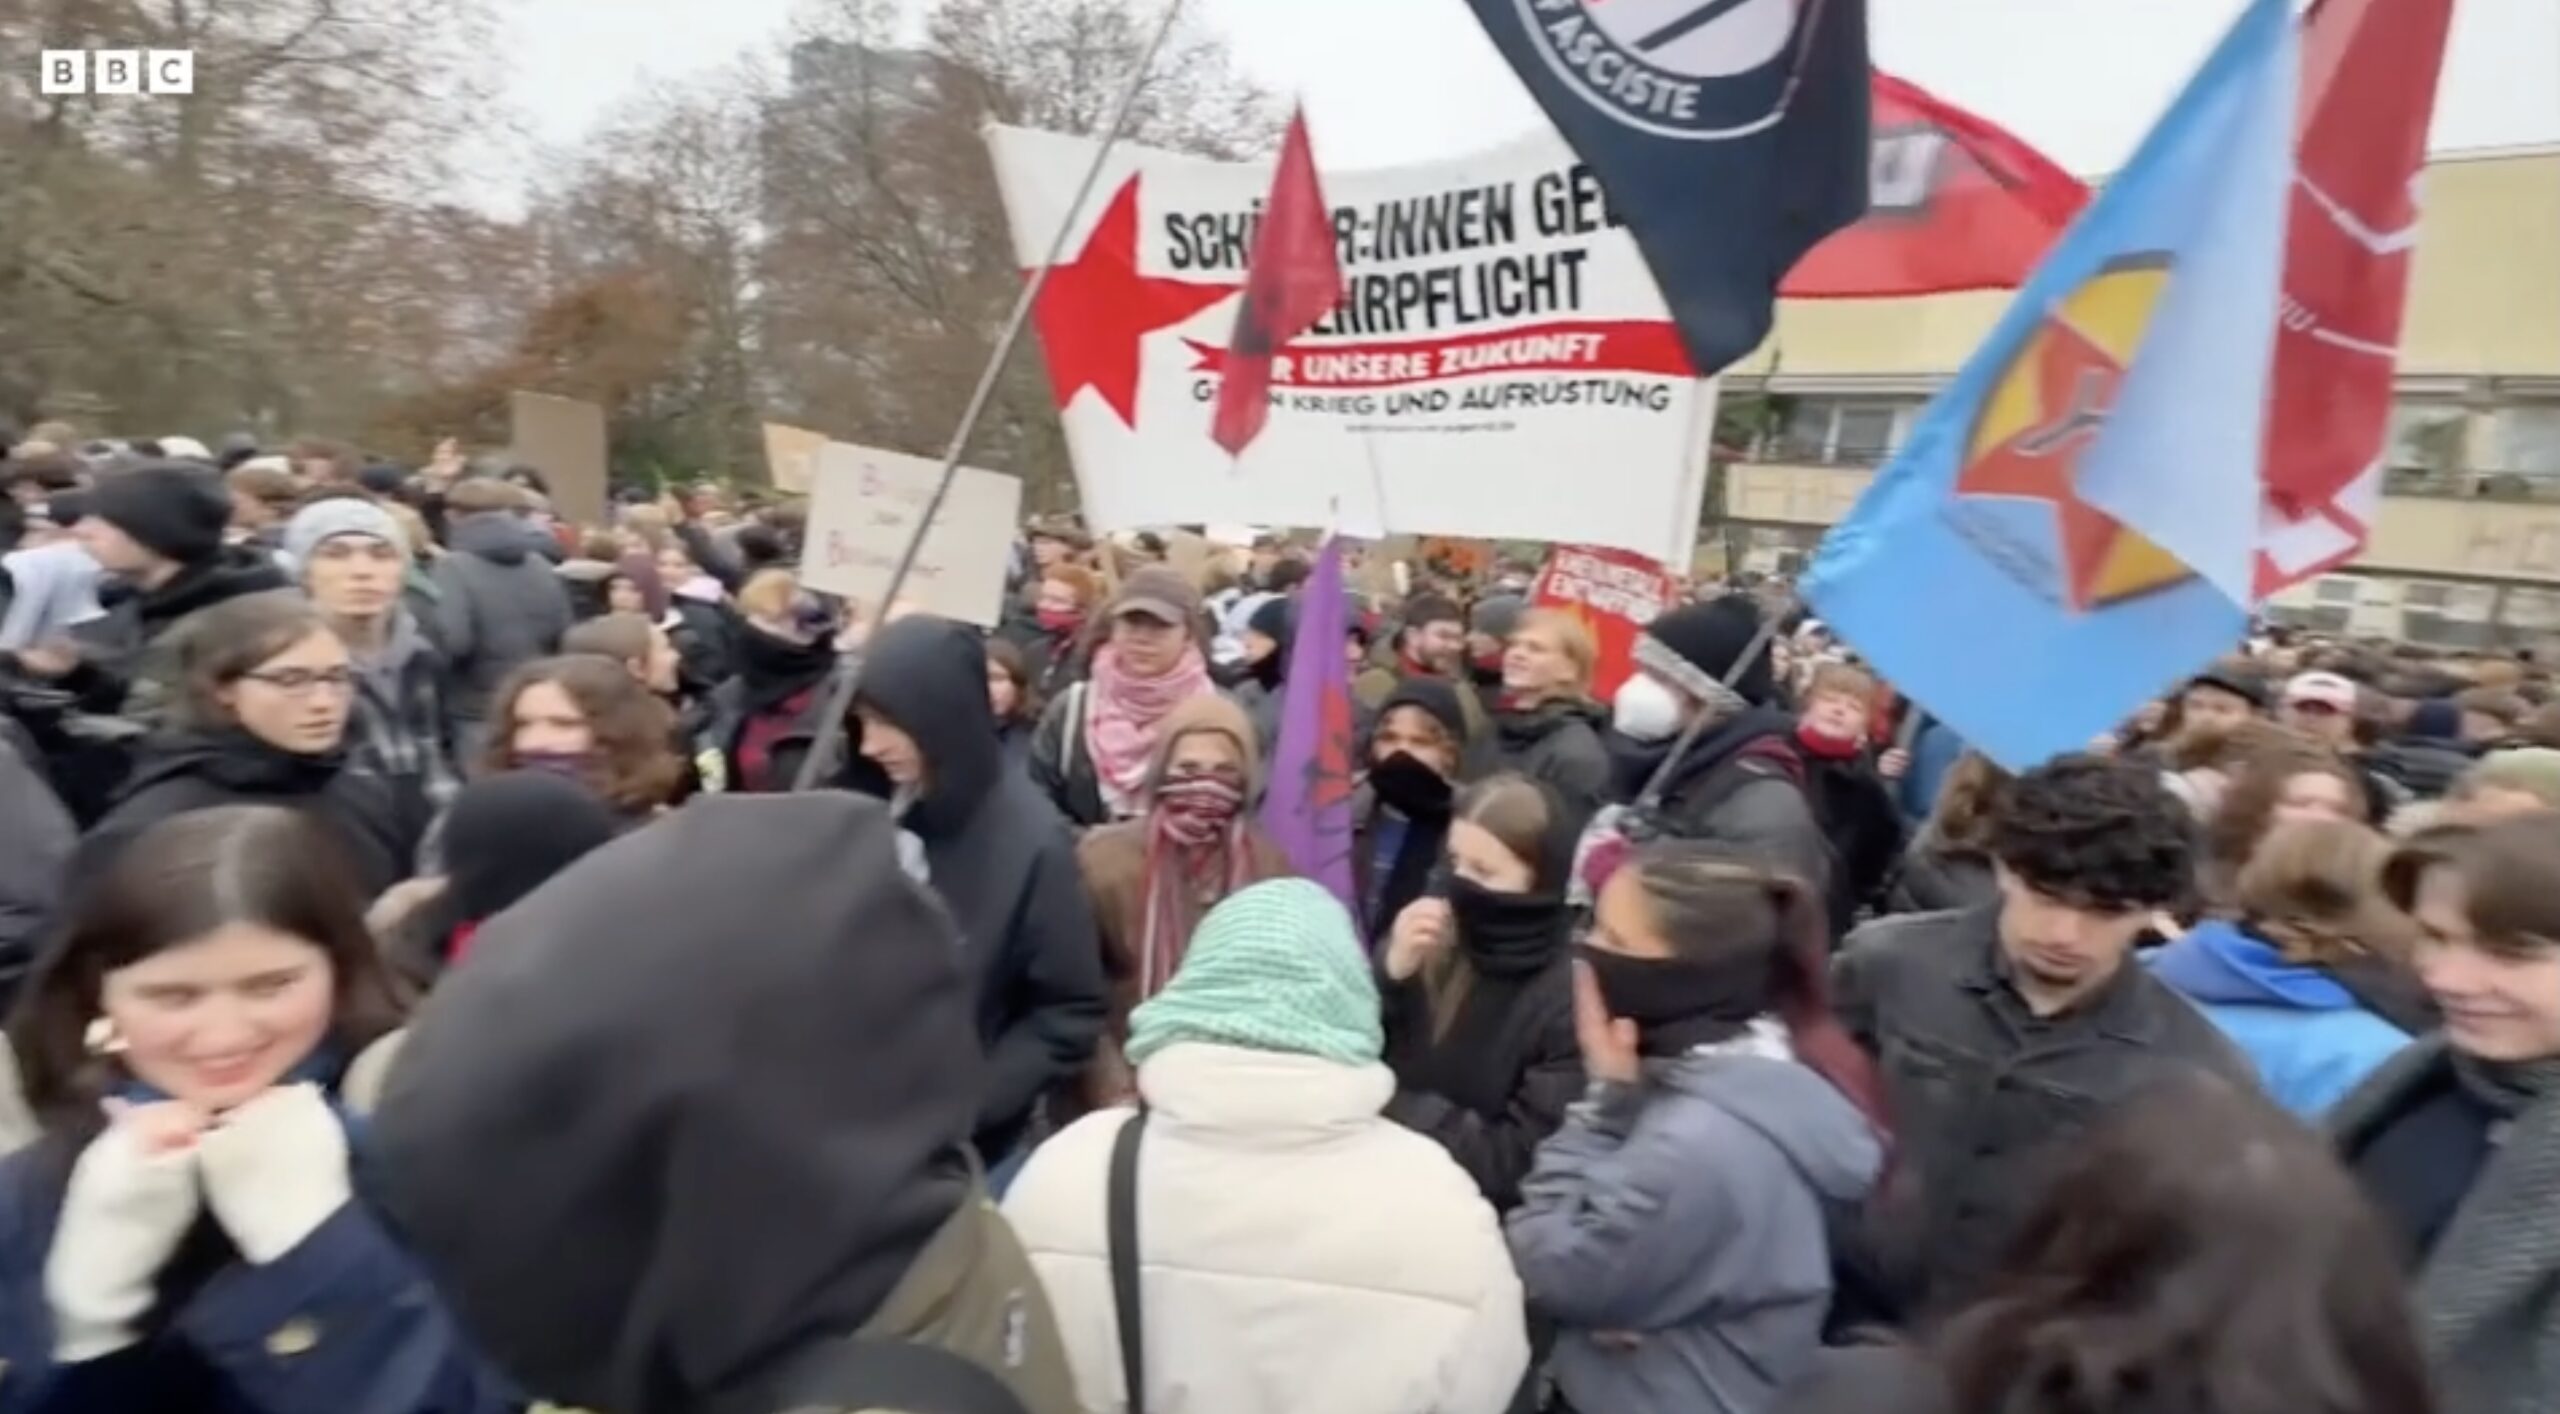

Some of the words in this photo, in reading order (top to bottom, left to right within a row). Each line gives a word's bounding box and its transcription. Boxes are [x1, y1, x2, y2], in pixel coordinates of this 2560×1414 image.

[1534, 0, 1701, 120] ASCISTE
[1164, 181, 1516, 270] SCHR:INNEN
[1303, 351, 1431, 383] UNSERE
[1438, 332, 1606, 374] ZUKUNFT
[1293, 394, 1376, 416] KRIEG
[1386, 389, 1449, 416] UND
[1459, 376, 1671, 413] AUFRÜSTUNG
